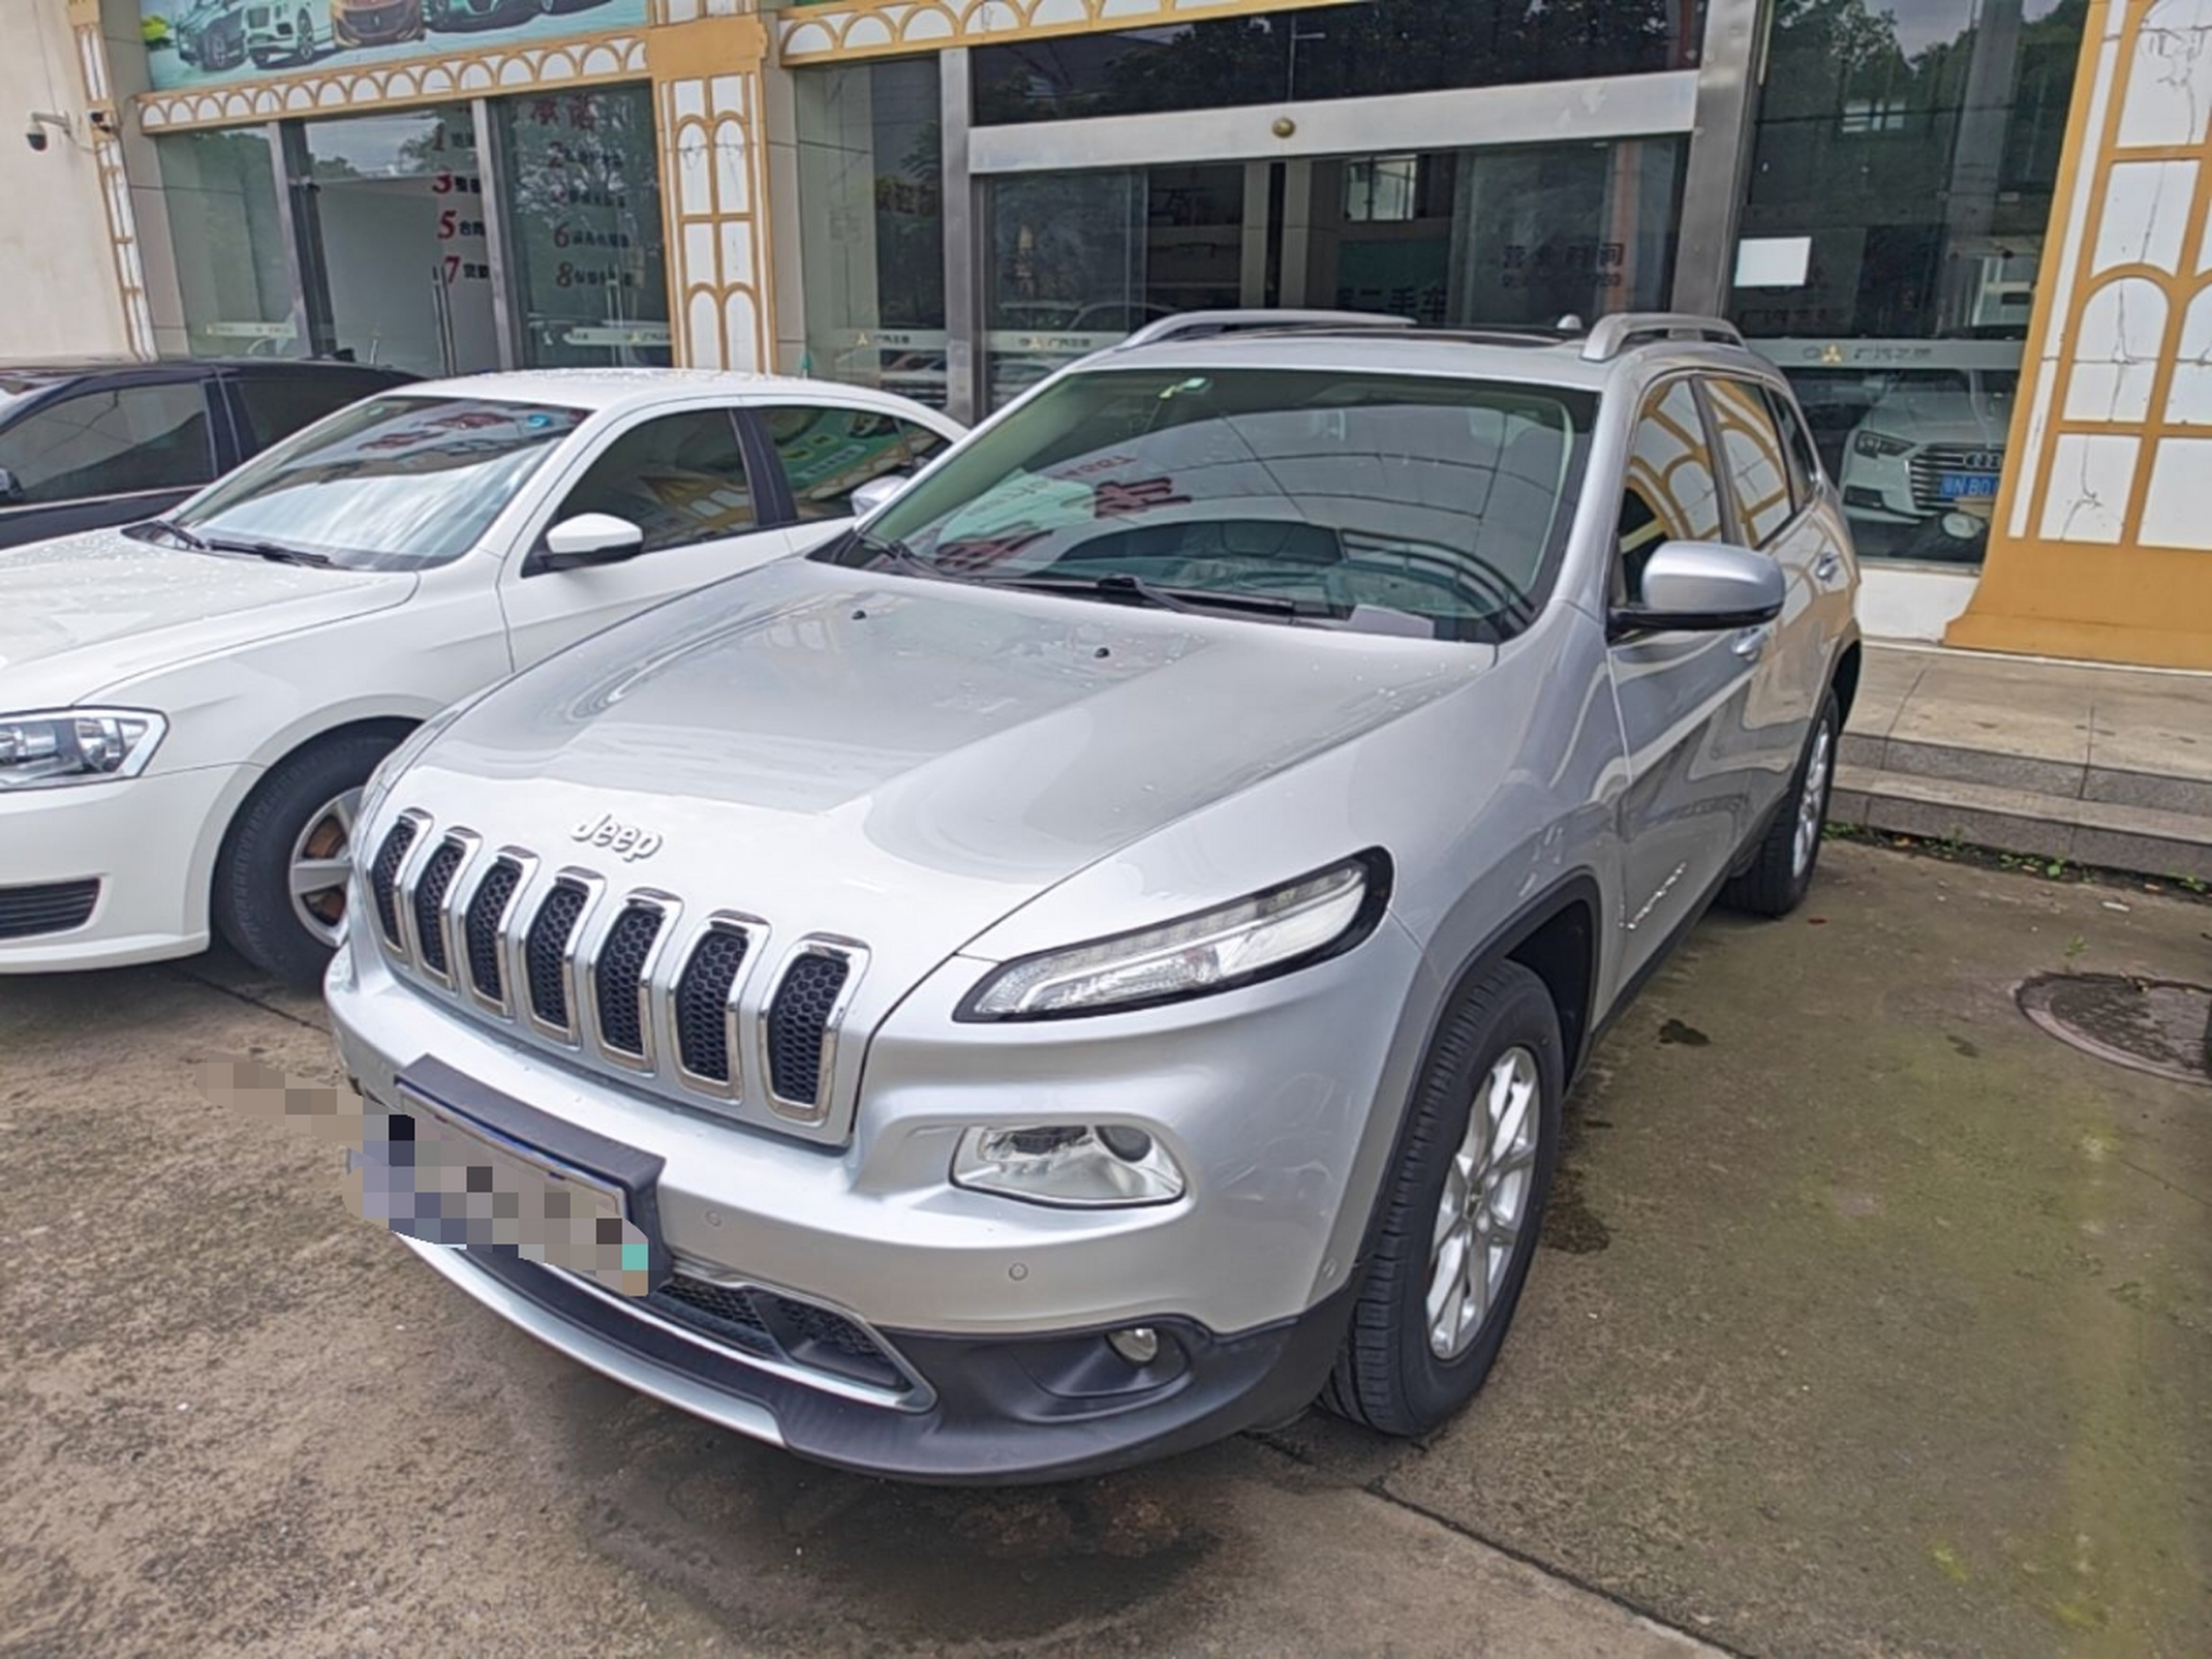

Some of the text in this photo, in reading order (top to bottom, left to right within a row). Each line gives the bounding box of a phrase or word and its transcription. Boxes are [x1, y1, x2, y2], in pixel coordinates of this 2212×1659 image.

[432, 165, 452, 194] 3
[437, 210, 457, 240] 5
[554, 221, 570, 248] 6
[445, 255, 461, 283] 7
[556, 262, 573, 287] 8
[570, 812, 663, 863] Jeep
